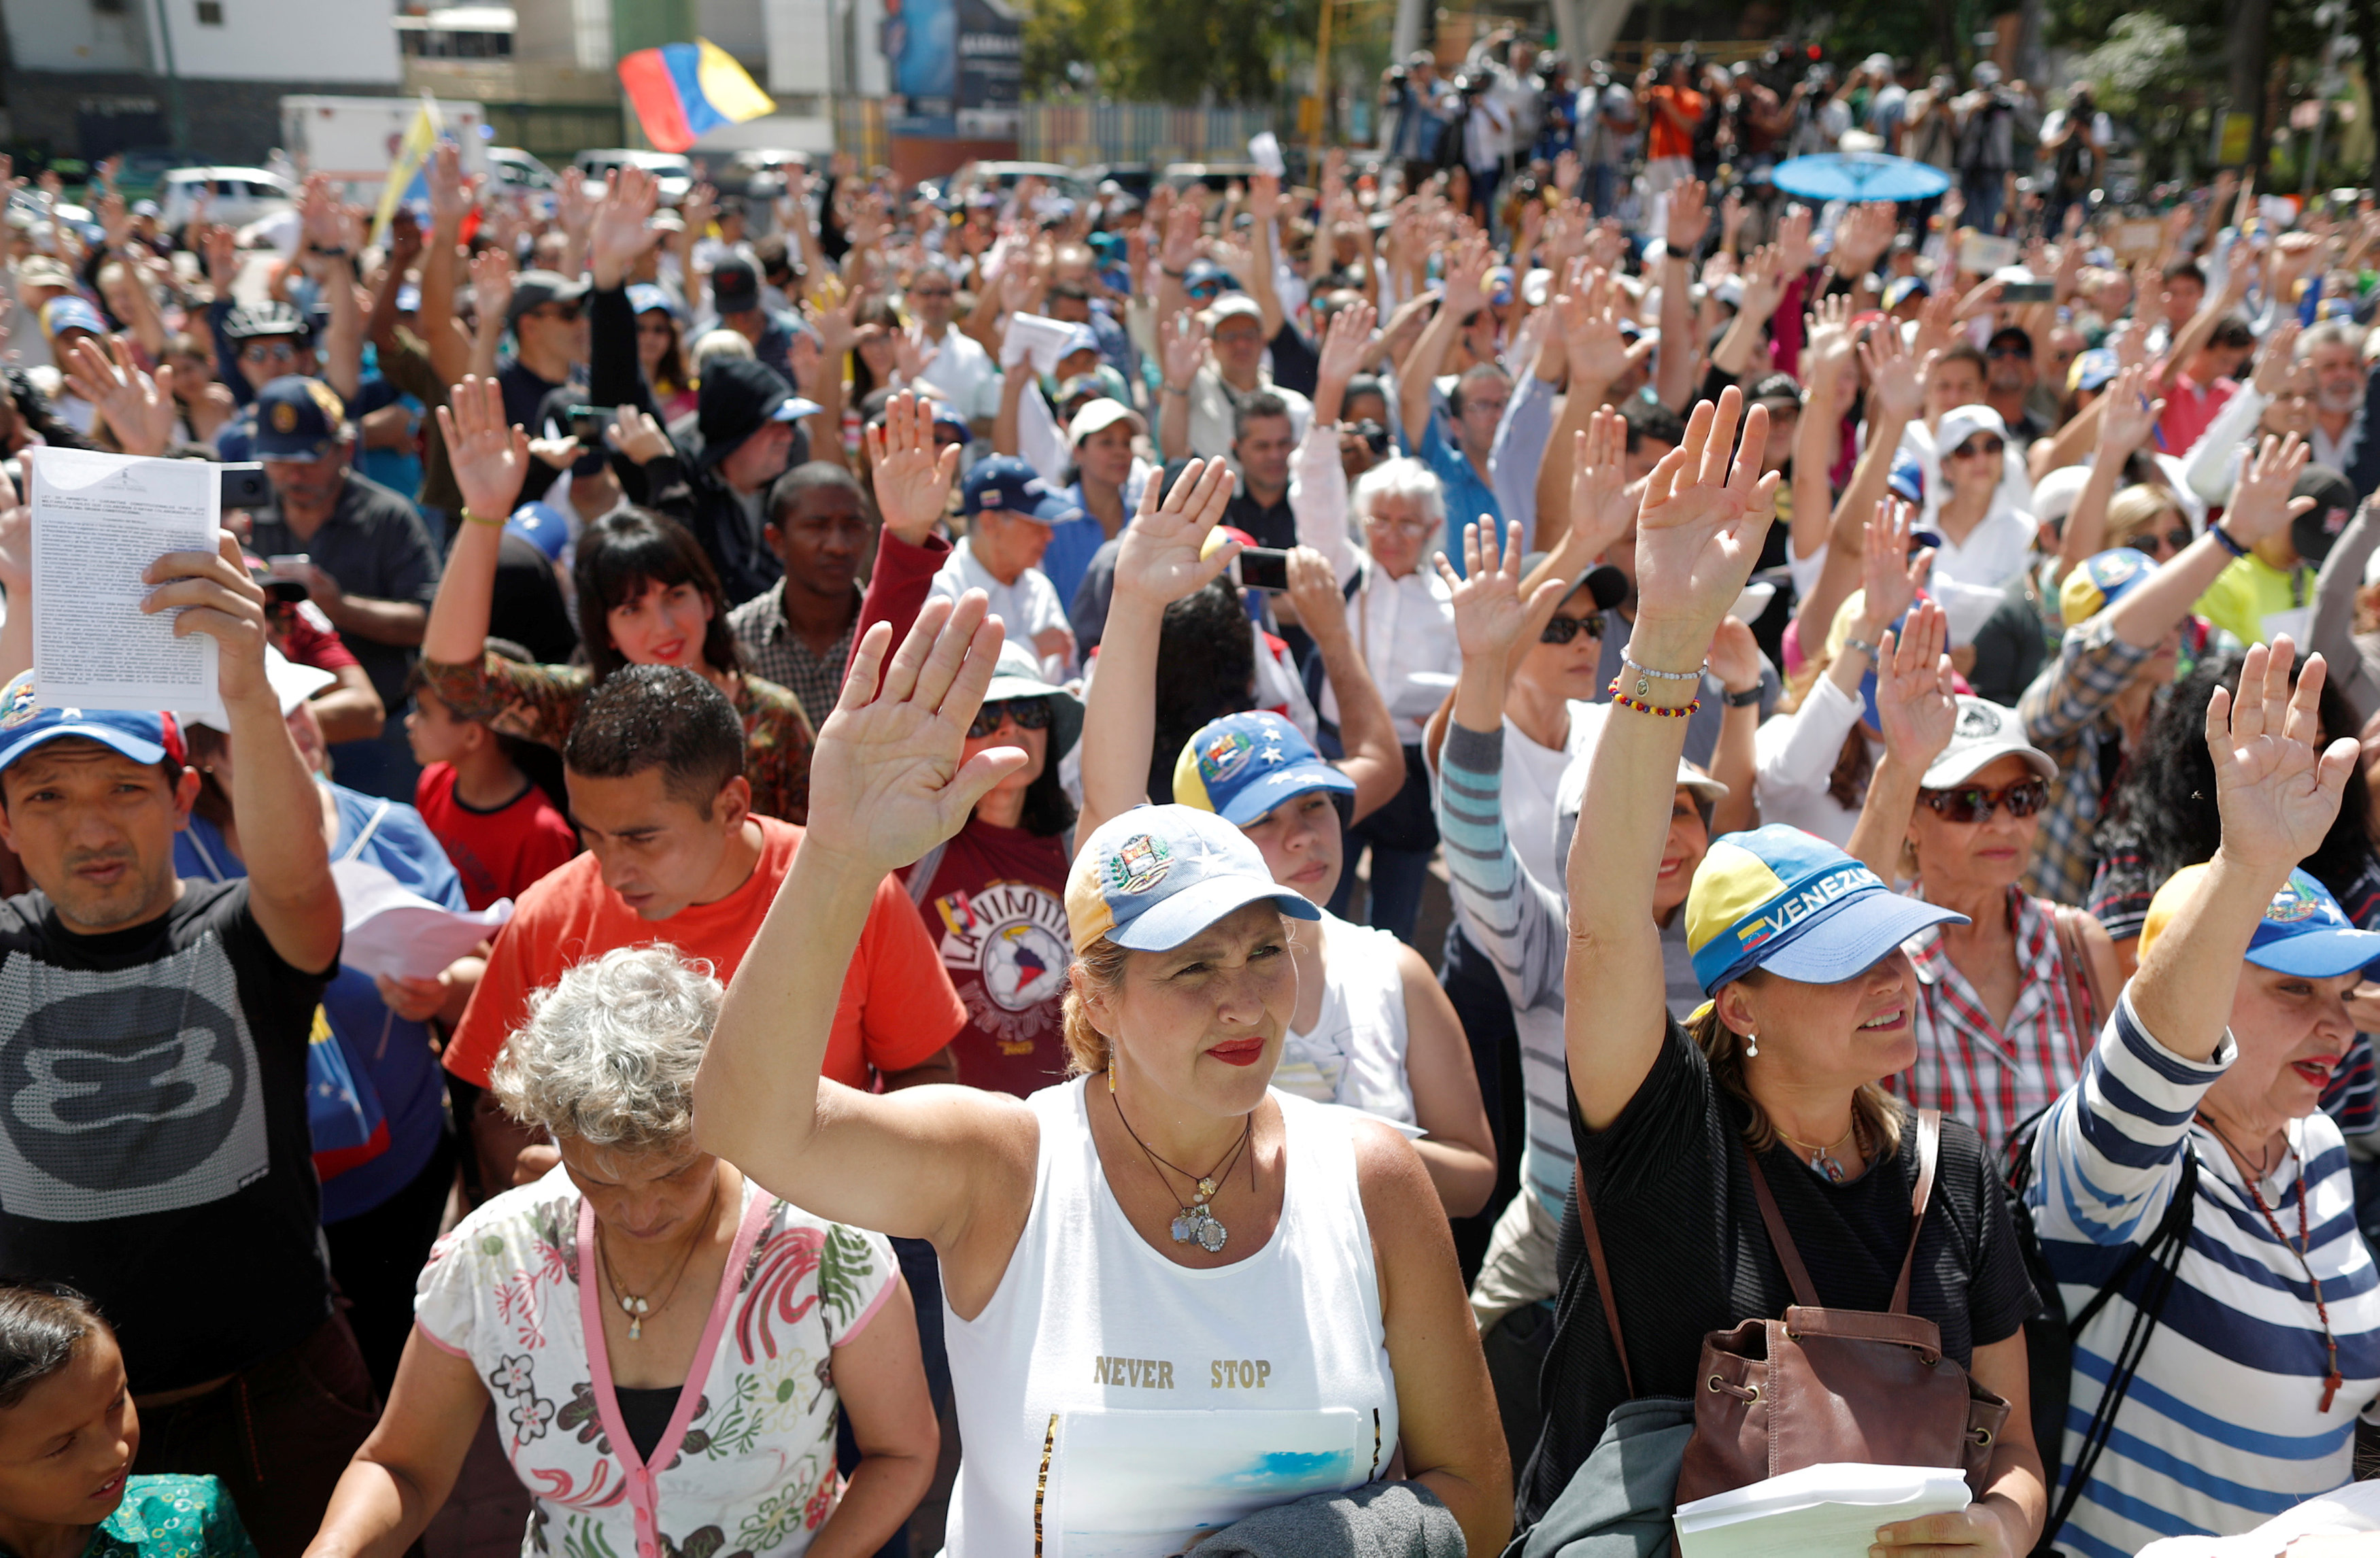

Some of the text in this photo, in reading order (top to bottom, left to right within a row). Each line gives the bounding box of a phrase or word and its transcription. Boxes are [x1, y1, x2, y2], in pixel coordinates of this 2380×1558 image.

[945, 932, 981, 963] LA
[1093, 1356, 1271, 1389] NEVER STOP
